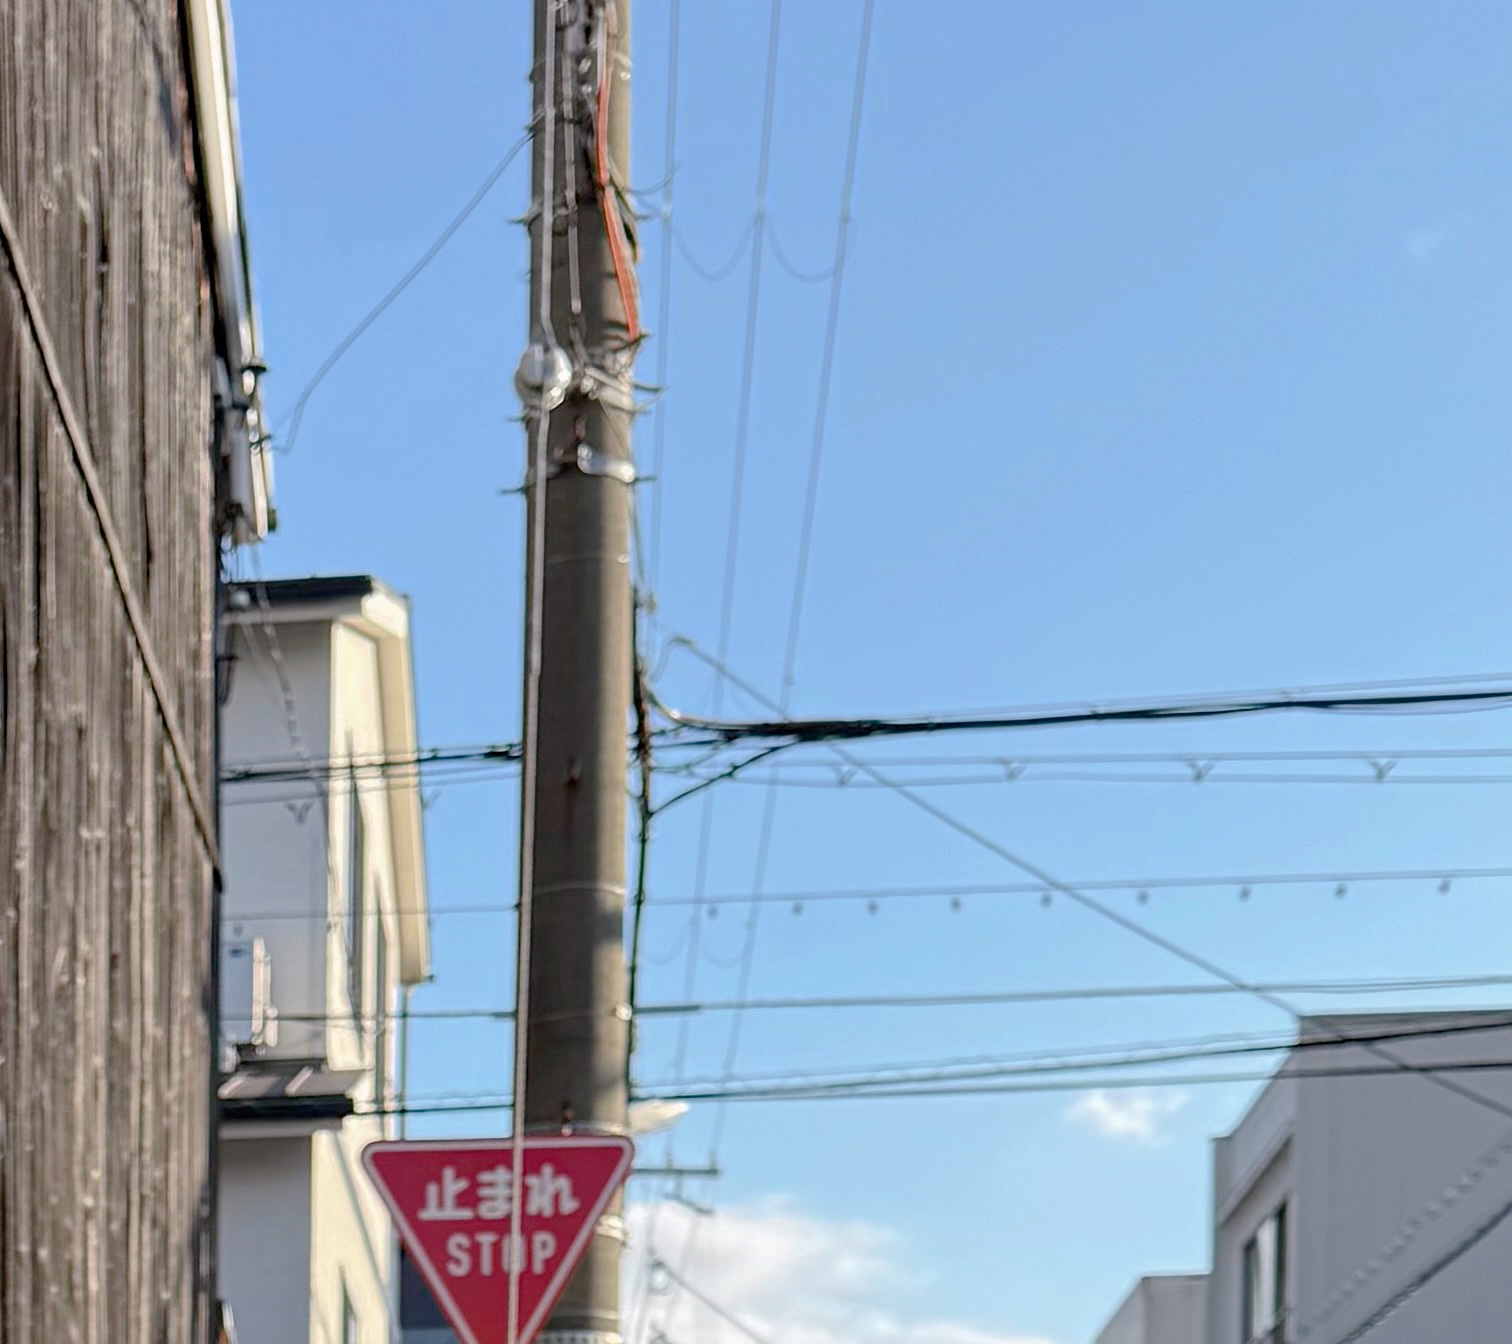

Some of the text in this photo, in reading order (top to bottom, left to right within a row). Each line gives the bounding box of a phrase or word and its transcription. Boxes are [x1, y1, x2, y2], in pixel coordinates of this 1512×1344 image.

[417, 1162, 580, 1220] 止まれ
[446, 1231, 556, 1277] STOP
